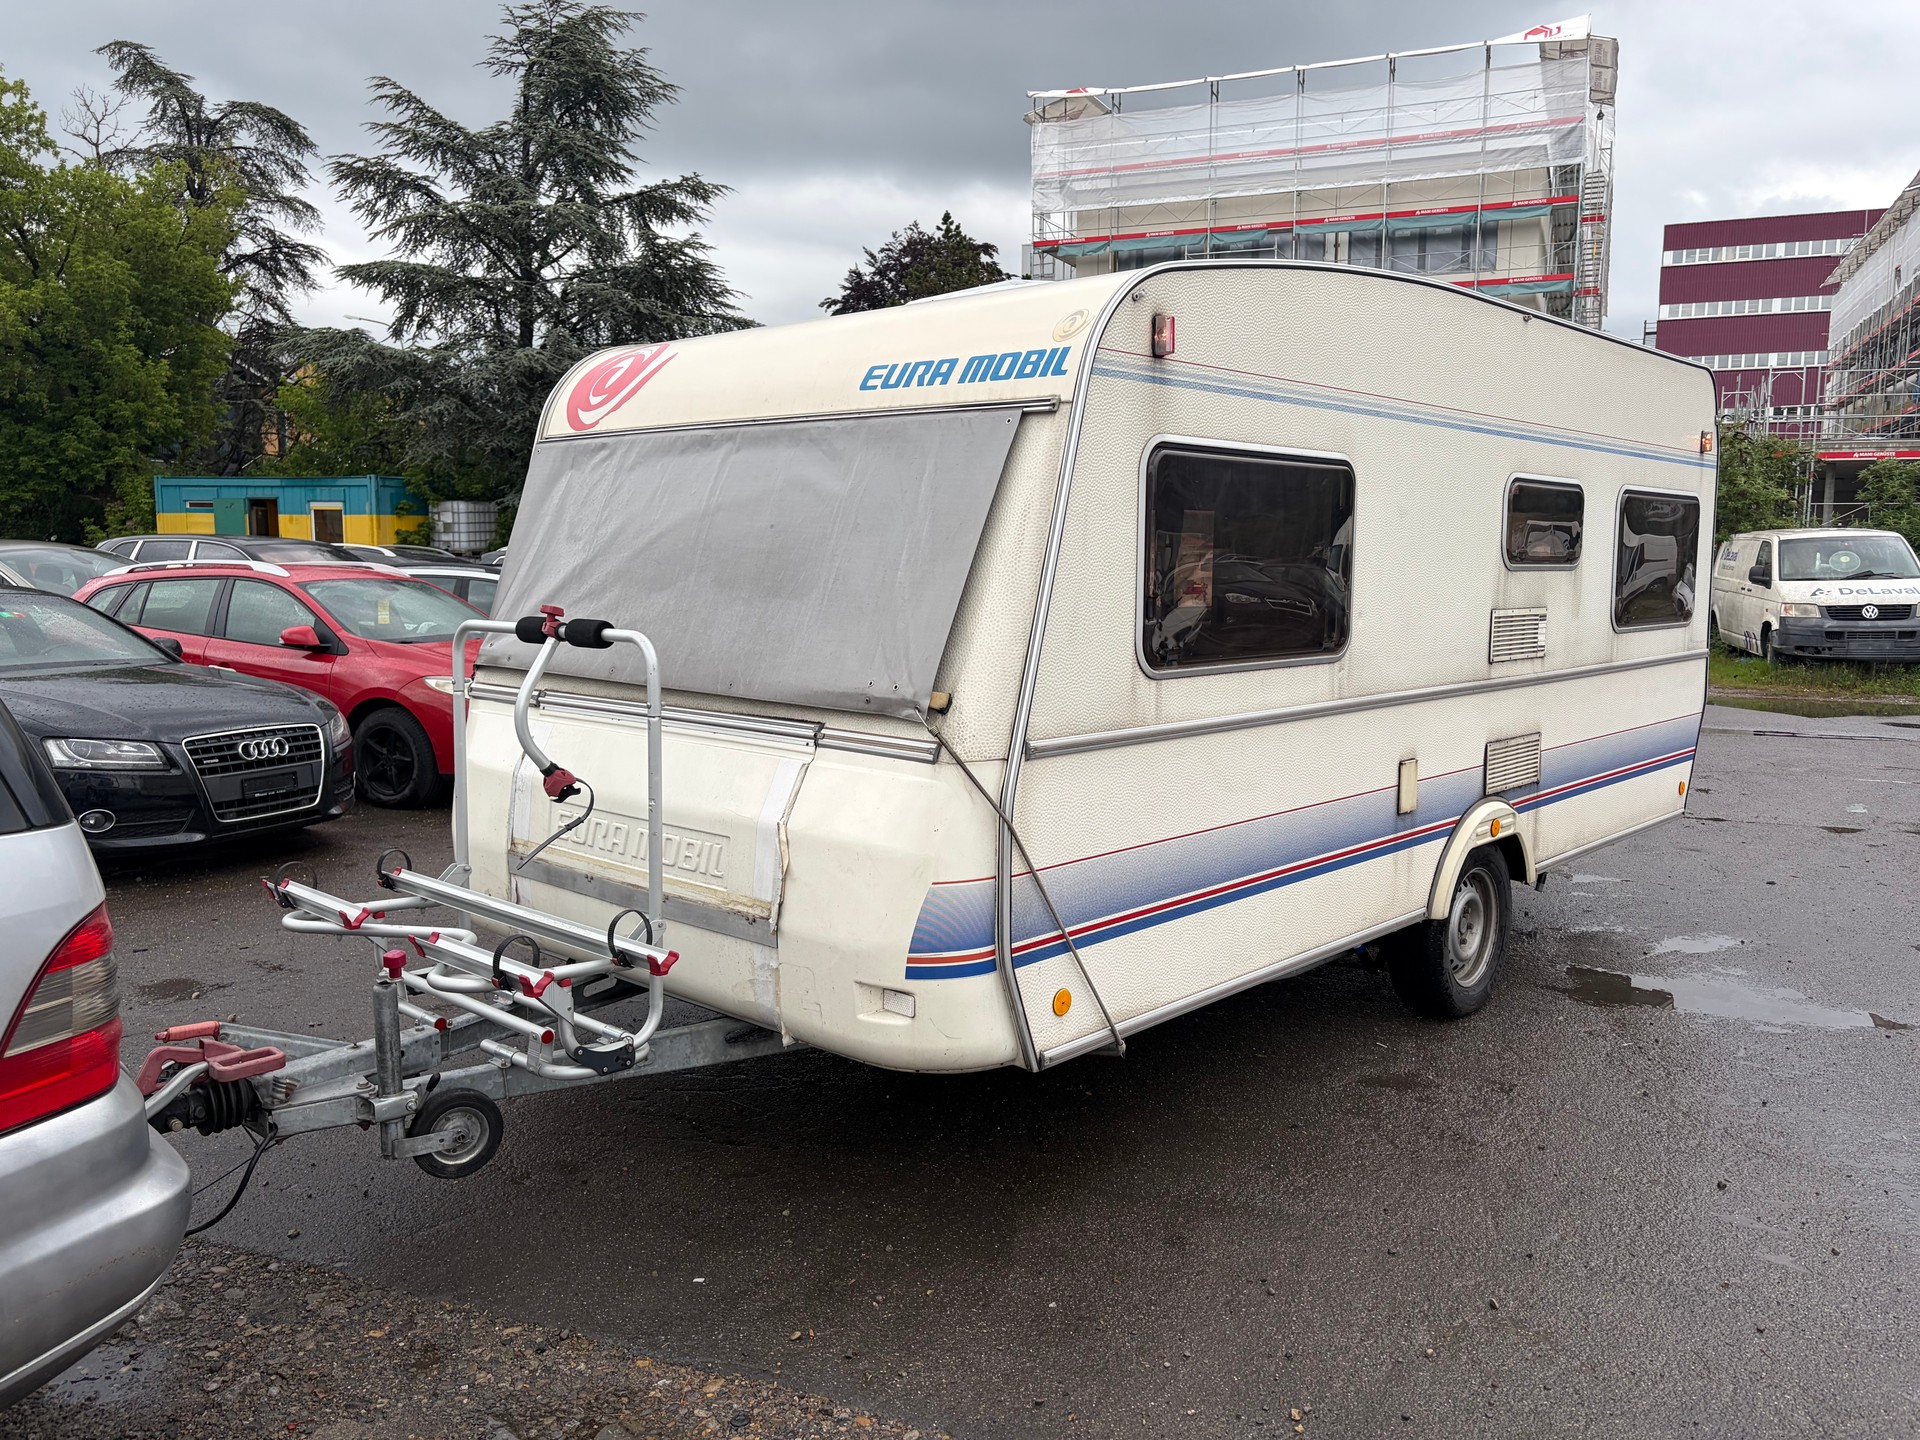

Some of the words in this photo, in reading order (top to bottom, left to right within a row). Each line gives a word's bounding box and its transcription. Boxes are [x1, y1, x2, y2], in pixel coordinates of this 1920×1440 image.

[859, 358, 959, 391] EURA
[957, 346, 1071, 384] MOBIL
[1838, 586, 1920, 596] DeLaval
[556, 809, 630, 856] EURA
